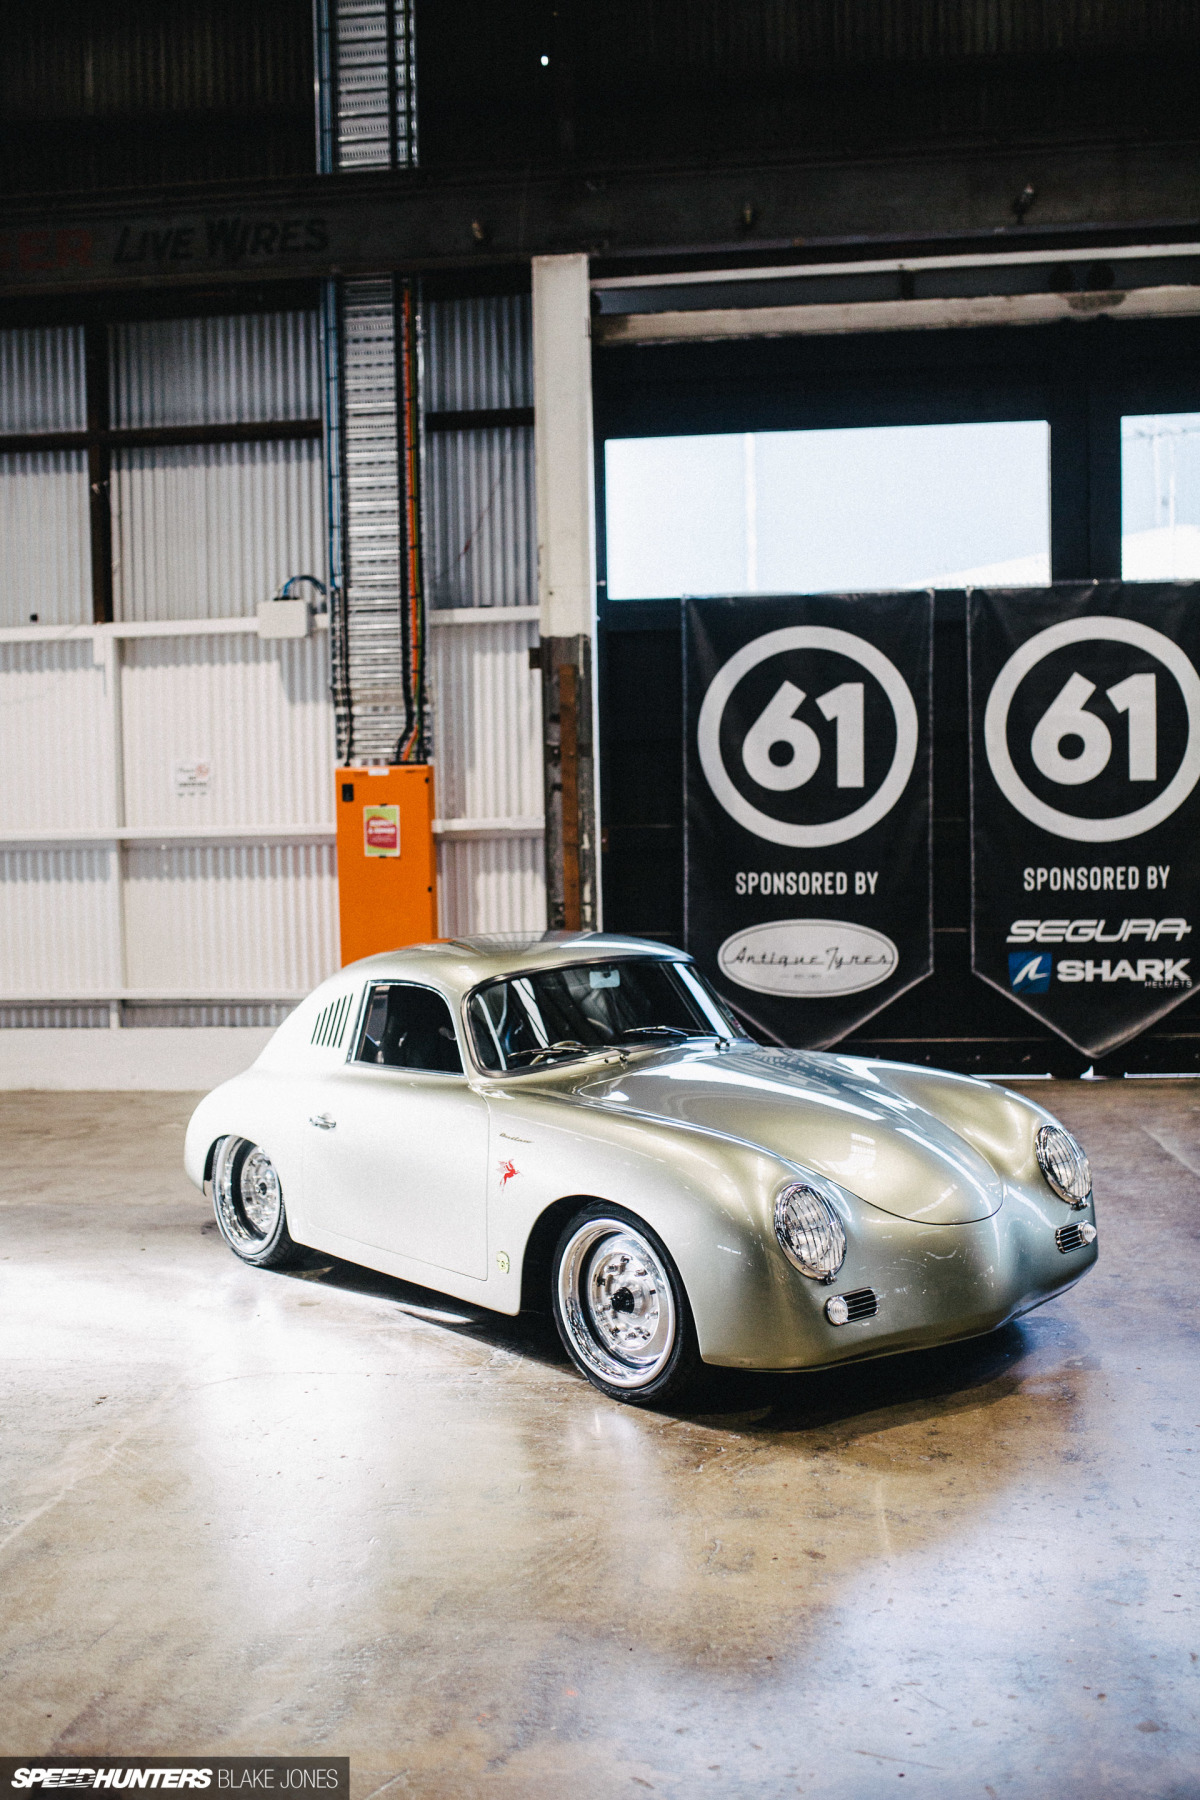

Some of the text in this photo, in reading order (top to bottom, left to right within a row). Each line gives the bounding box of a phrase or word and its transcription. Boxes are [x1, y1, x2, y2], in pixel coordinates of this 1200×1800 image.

[113, 226, 195, 263] LIVE
[205, 216, 328, 261] WIRES
[742, 681, 864, 791] 61
[1031, 672, 1157, 785] 61
[736, 871, 878, 895] SPONSORED BY
[1023, 865, 1170, 891] SPONSORED BY
[1006, 918, 1192, 943] SEGURA
[729, 947, 893, 971] Antique Tyres
[1056, 958, 1191, 983] SHARK
